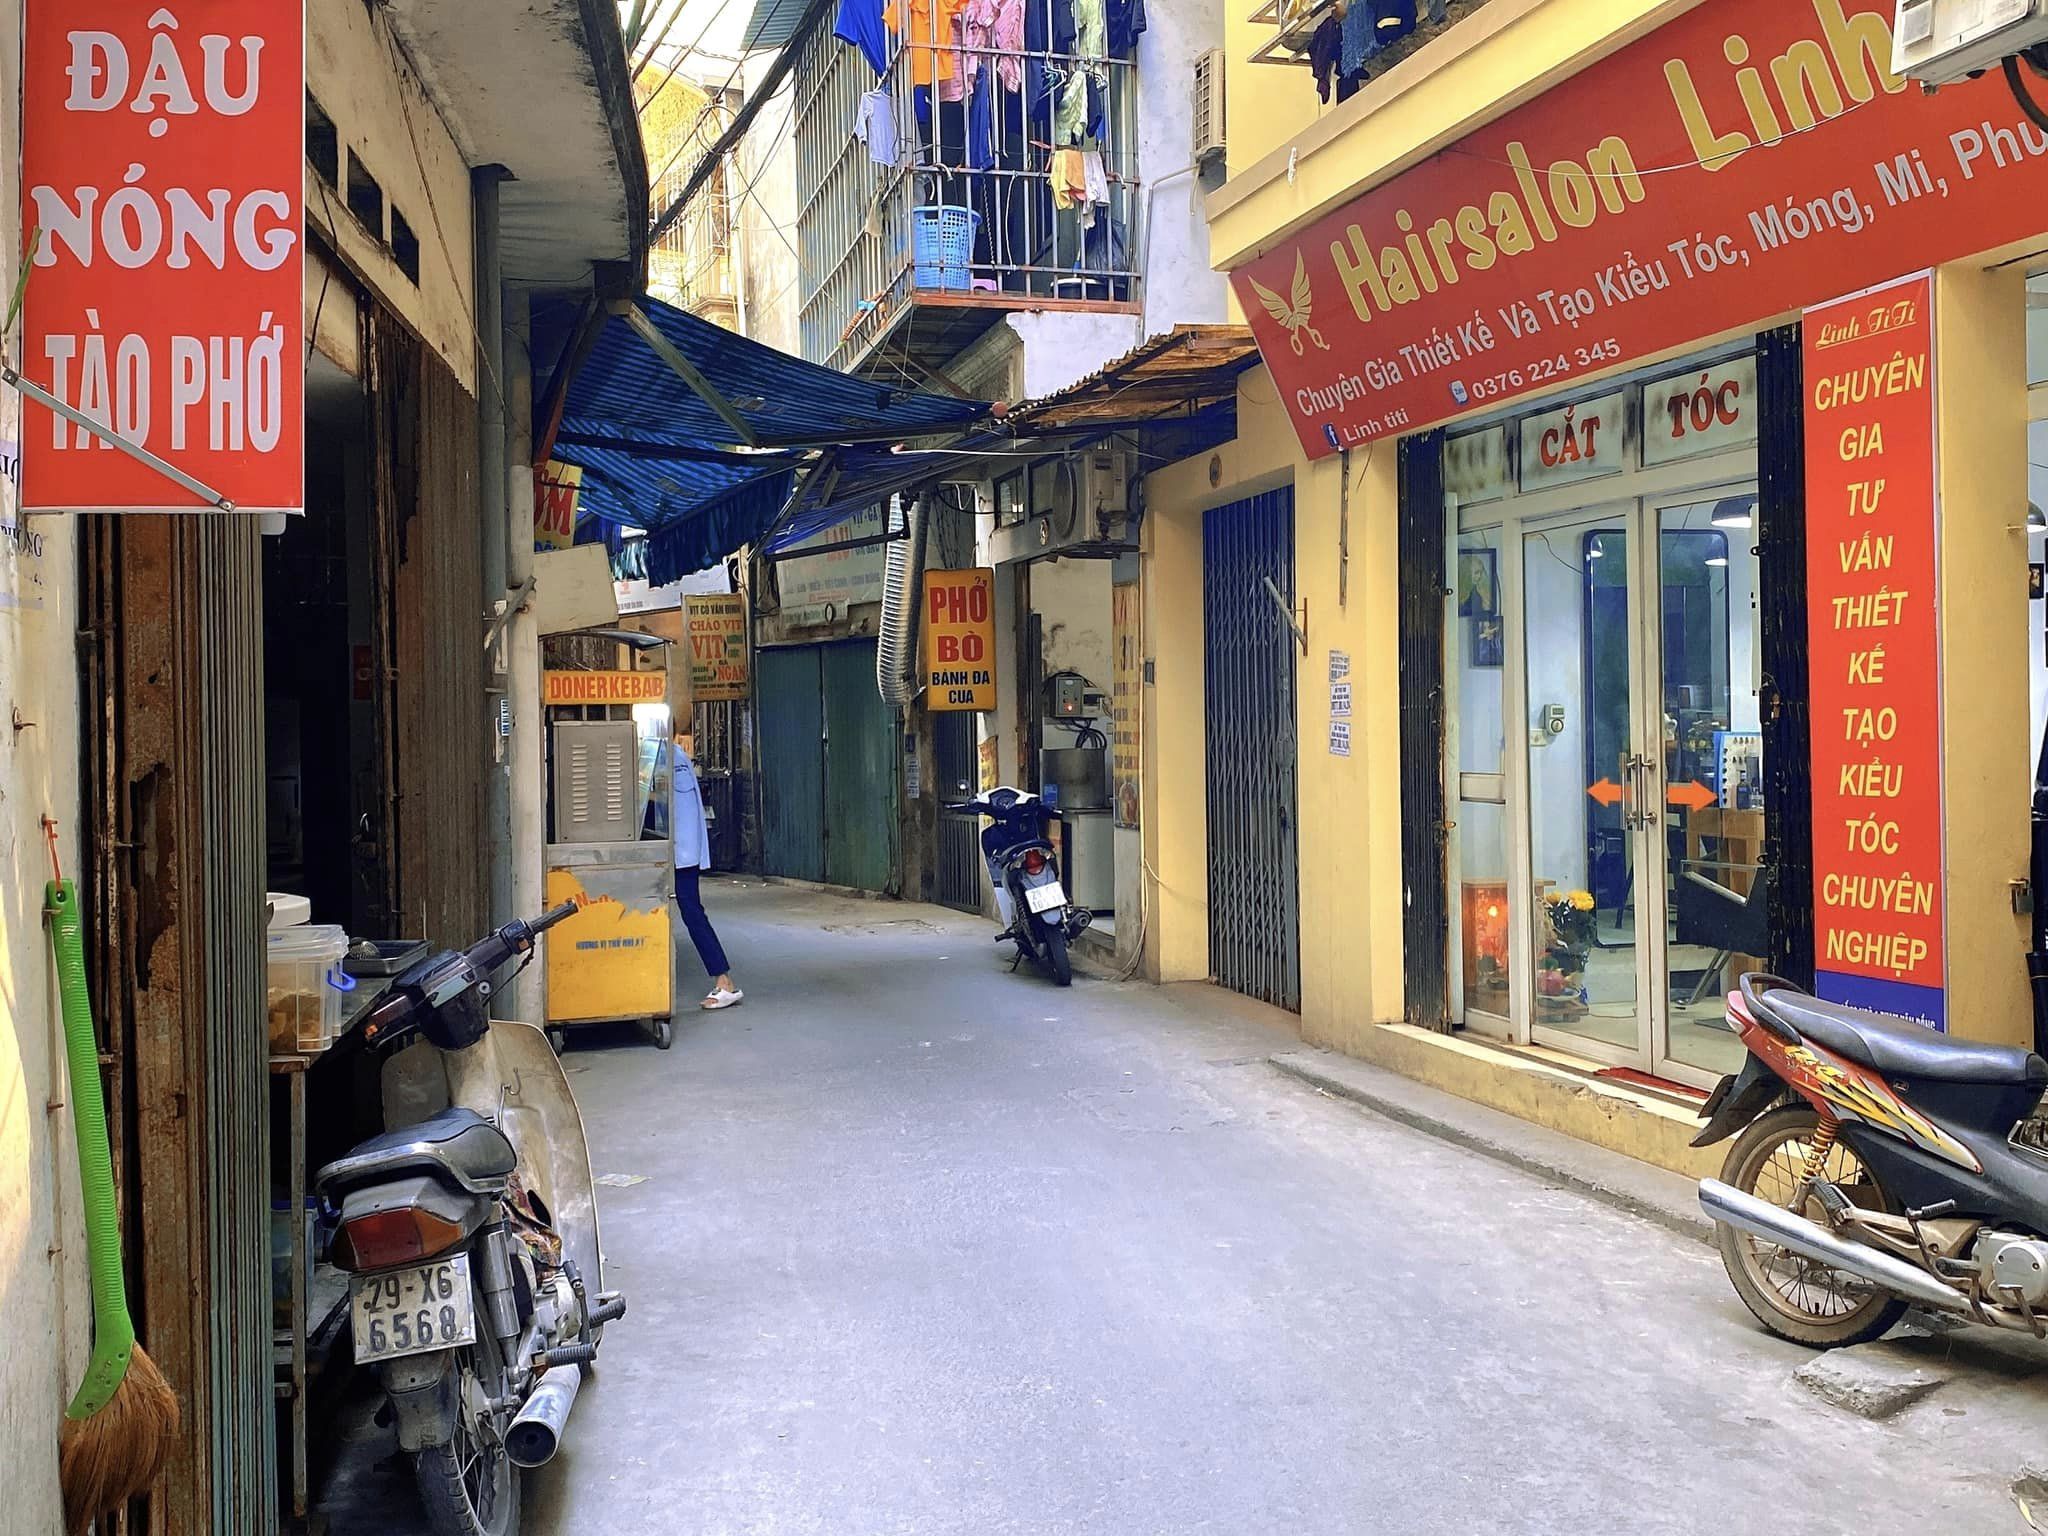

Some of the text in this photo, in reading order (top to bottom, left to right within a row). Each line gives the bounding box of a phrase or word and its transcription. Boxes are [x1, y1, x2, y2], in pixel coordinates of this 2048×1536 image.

[63, 8, 266, 138] ĐẬU
[1329, 0, 1908, 323] Hairsalon Linh
[30, 162, 297, 271] NÓNG
[1296, 362, 1369, 417] Chuyên
[1364, 352, 1402, 392] Gia
[1399, 325, 1461, 377] Thiết
[1457, 309, 1496, 357] Kế
[1498, 300, 1542, 341] Và
[1537, 285, 1595, 329] Tạo
[1594, 250, 1670, 308] Kiểu
[1667, 231, 1751, 280] Tóc,
[1748, 195, 1876, 253] Móng,
[1875, 148, 1950, 206] Mi,
[1815, 315, 1860, 349] Linh
[44, 308, 285, 454] TÀO PHỚ
[1472, 338, 1622, 400] 0376 224 345
[1814, 350, 1926, 411] CHUYÊN
[1343, 419, 1382, 442] Linh
[1539, 372, 1741, 468] CẮT TÓC
[1838, 423, 1884, 461] GIA
[1847, 478, 1885, 516] TƯ
[1838, 531, 1893, 573] VẤN
[929, 576, 987, 624] PHỞ
[1832, 585, 1908, 630] THIẾT
[689, 617, 742, 633] CHÁO VỊT
[938, 630, 984, 663] BÒ
[690, 634, 723, 663] VỊT
[1847, 643, 1886, 685] KẾ
[932, 669, 991, 686] BÁNH ĐA
[949, 689, 975, 705] CUA
[1842, 707, 1897, 748] TẠO
[1839, 756, 1903, 798] KIỂU
[1845, 812, 1901, 856] TÓC
[1822, 872, 1935, 916] CHUYÊN
[1826, 927, 1928, 977] NGHIỆP
[363, 1265, 454, 1314] 29-X6
[369, 1304, 457, 1353] 6568
